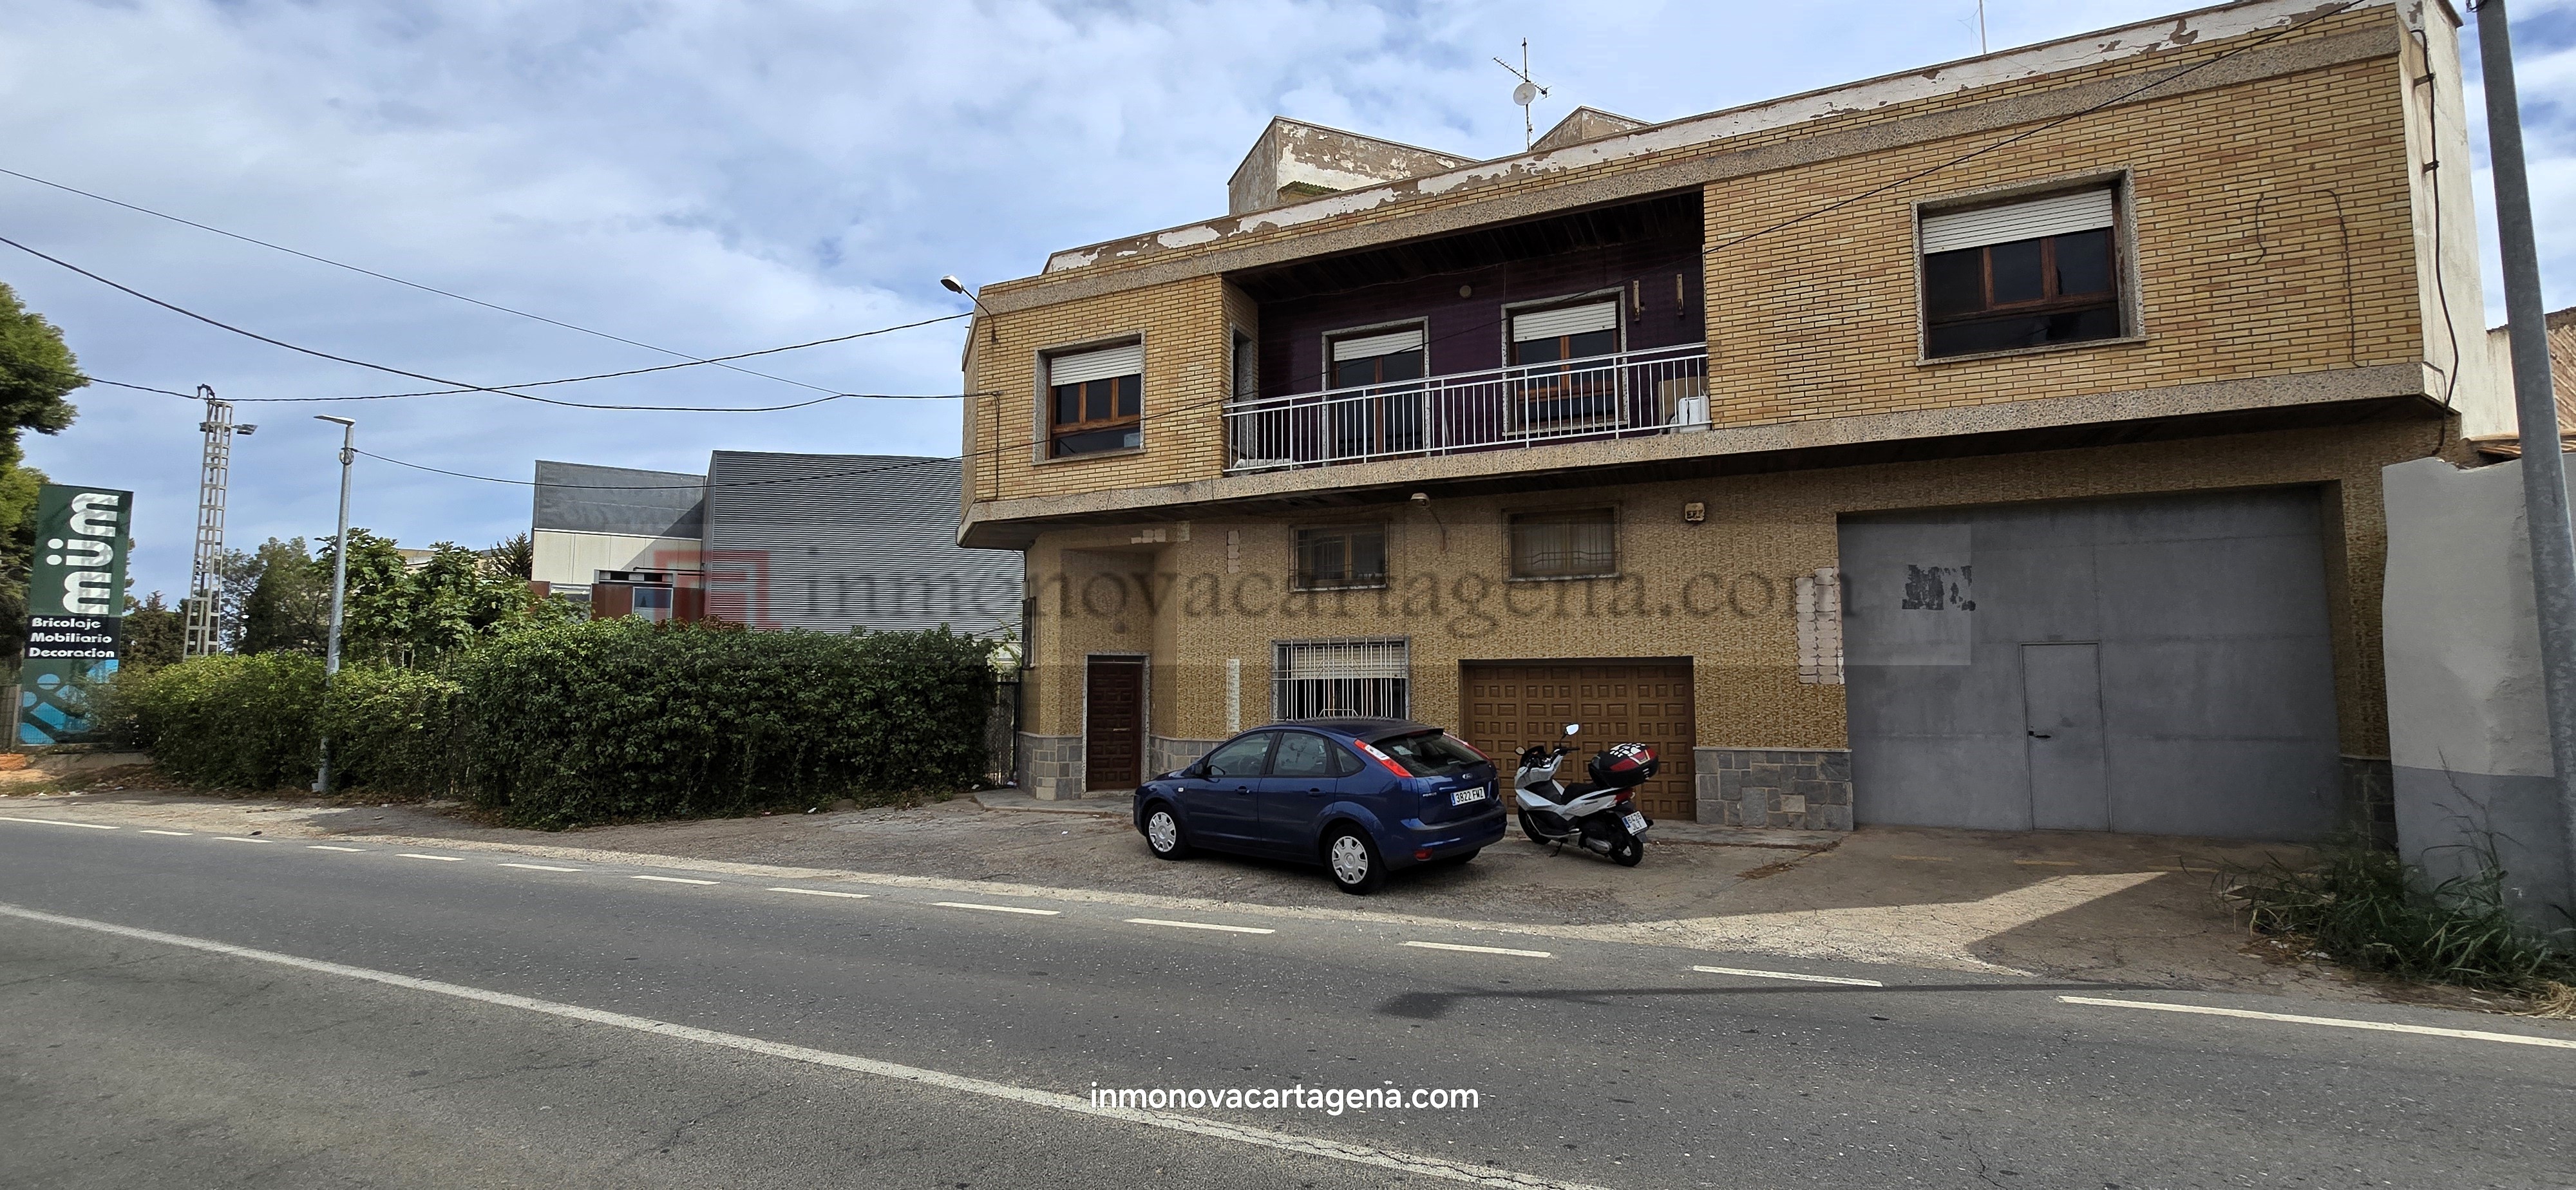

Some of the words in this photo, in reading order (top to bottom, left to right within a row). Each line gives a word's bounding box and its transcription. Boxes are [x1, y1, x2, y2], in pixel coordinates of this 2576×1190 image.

[32, 618, 101, 630] Bricolaje
[30, 632, 112, 643] Mobiliario
[29, 647, 115, 658] Decoracion
[1456, 791, 1472, 803] 3822
